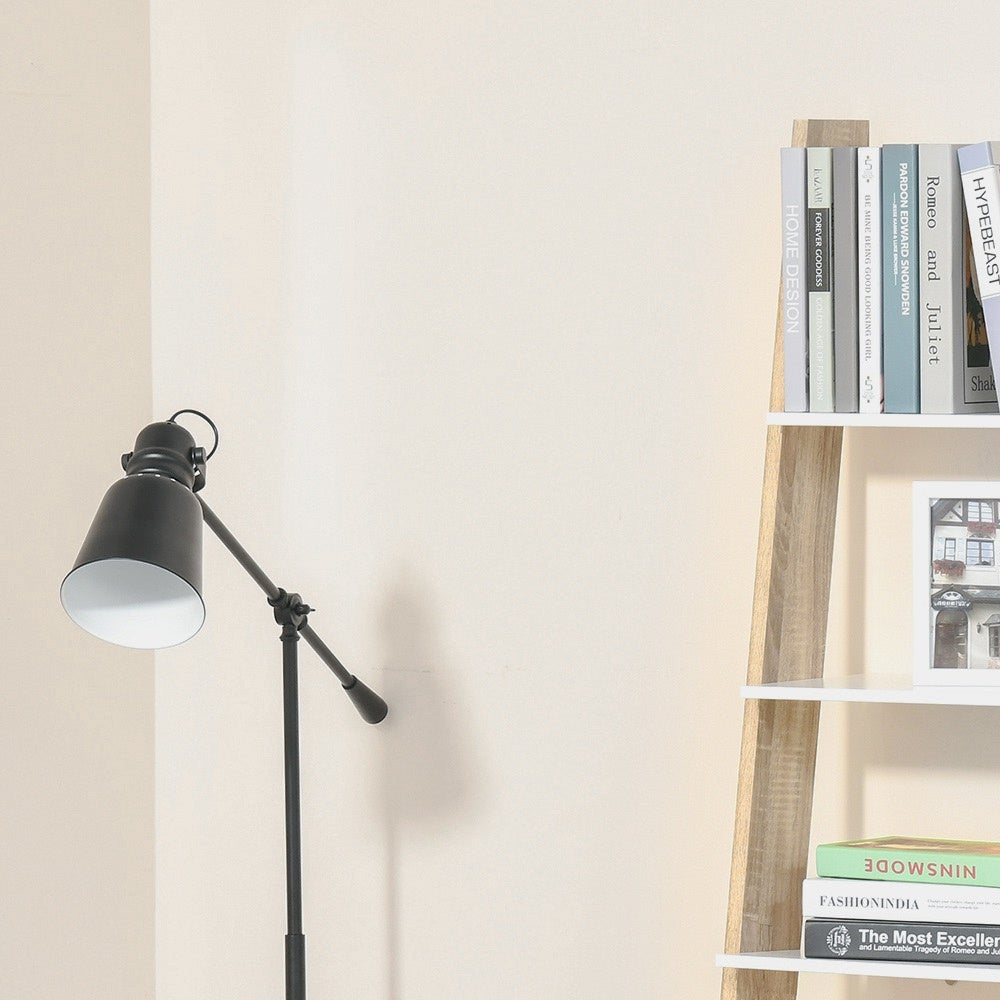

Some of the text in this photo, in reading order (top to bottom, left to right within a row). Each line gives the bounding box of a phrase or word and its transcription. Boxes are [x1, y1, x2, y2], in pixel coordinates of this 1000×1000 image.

[865, 194, 871, 207] BE
[815, 212, 823, 287] FOREVER GODDESS
[899, 163, 910, 315] PARDON EDWARD SNOWDEN
[973, 177, 1000, 285] HYPEBEAST
[786, 205, 800, 333] HOME DESIGN
[926, 176, 941, 365] Romeo and Juliet
[864, 858, 976, 879] NINSMODE
[820, 895, 919, 910] FASHIONINDIA
[858, 929, 889, 944] The
[893, 930, 933, 946] Most
[873, 944, 913, 952] Lamentable
[914, 945, 941, 955] Tragedy
